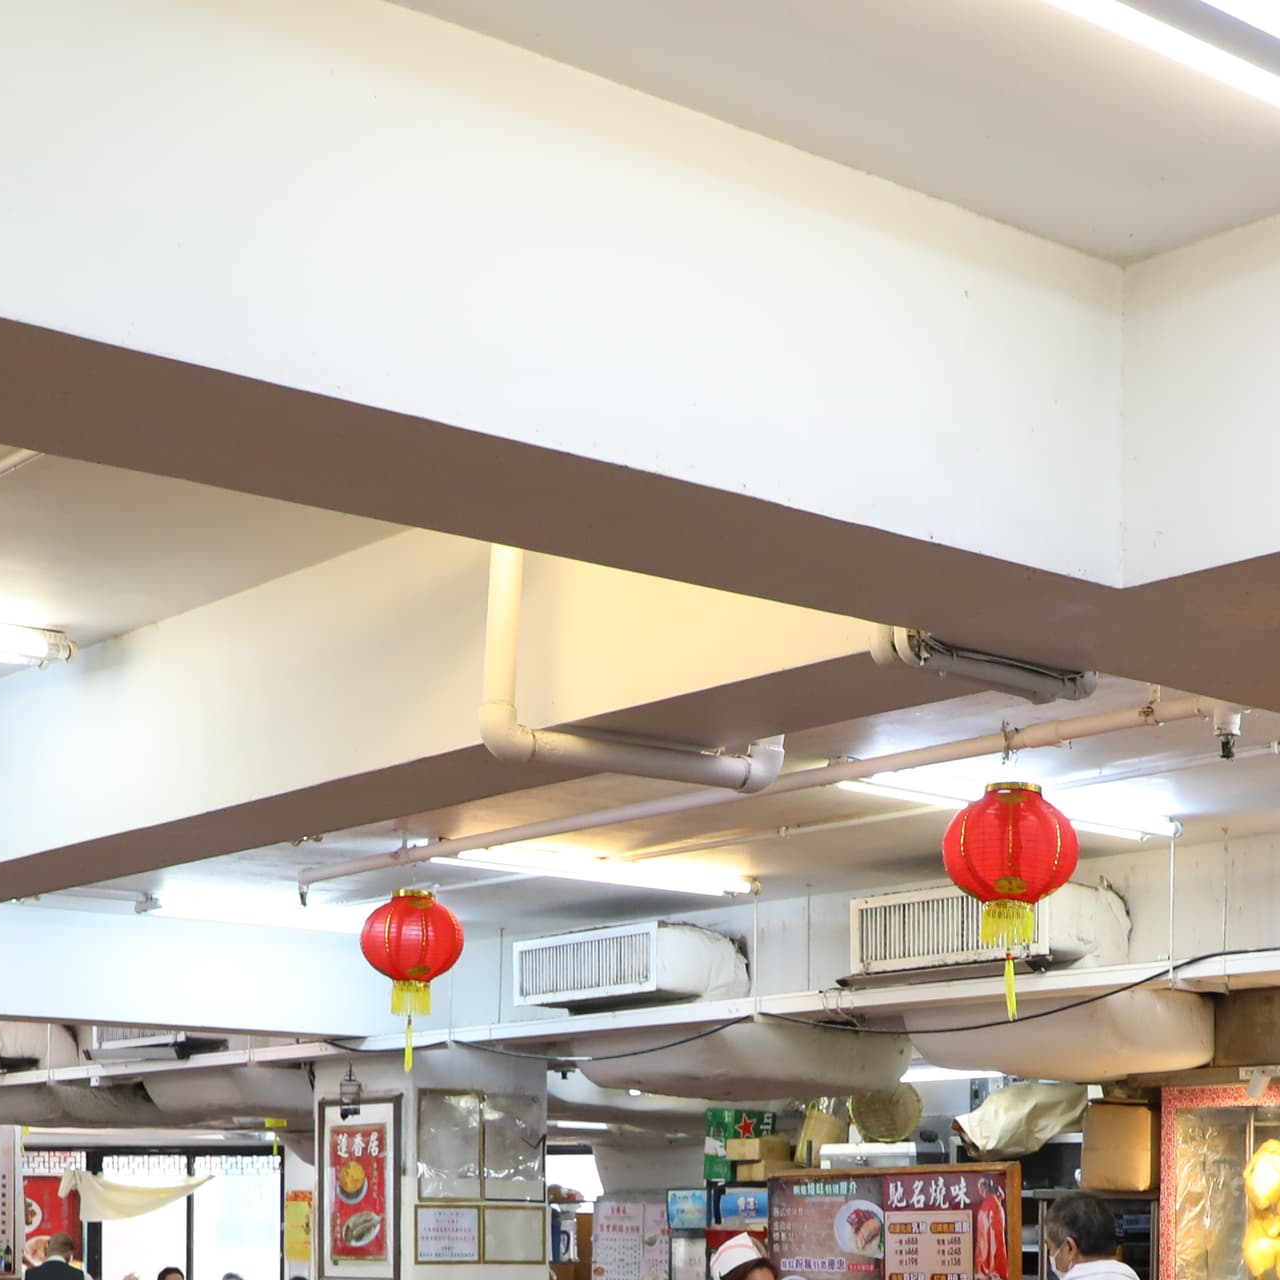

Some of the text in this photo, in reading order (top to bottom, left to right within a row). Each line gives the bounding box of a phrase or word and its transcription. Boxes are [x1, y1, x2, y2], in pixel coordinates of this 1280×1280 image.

[337, 1132, 380, 1158] 蓮香居
[888, 1176, 971, 1209] 馳名燒味
